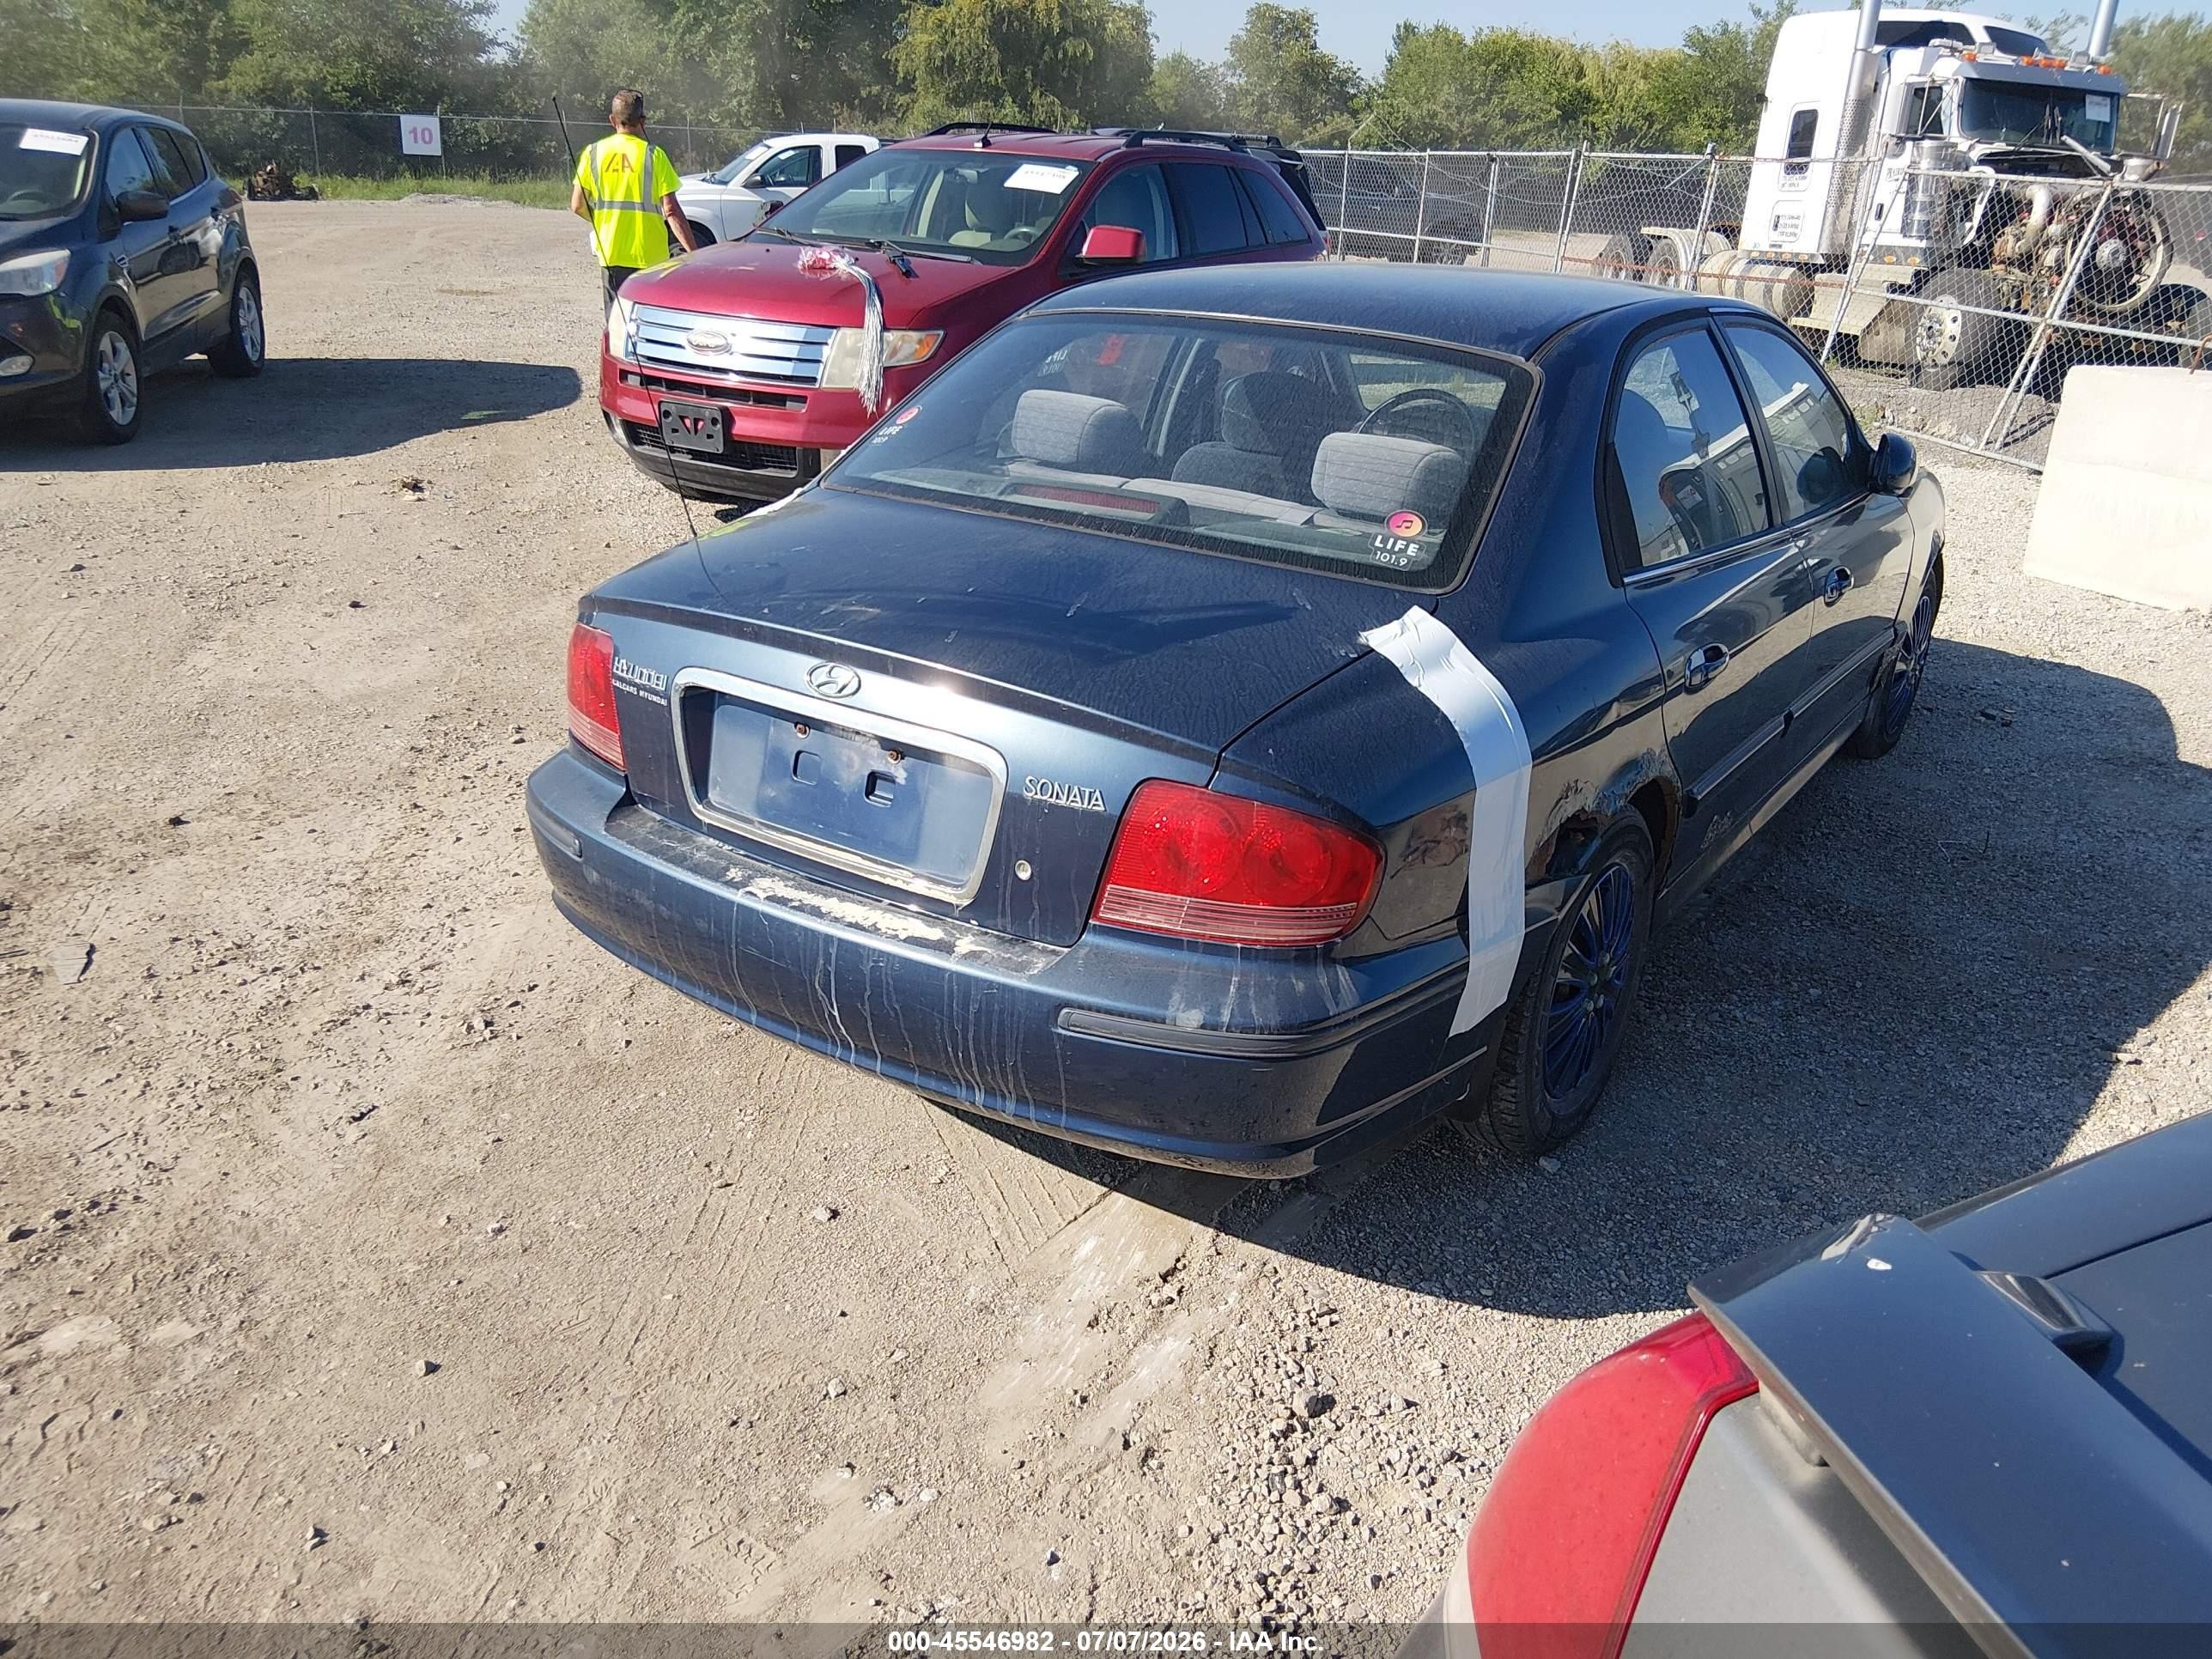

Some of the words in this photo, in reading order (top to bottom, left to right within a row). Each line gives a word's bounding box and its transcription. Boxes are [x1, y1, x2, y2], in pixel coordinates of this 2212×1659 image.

[409, 126, 434, 145] 10
[1374, 534, 1419, 556] LIFE
[1375, 550, 1408, 567] 101.9
[612, 657, 668, 691] HYUNDAI
[639, 690, 668, 707] HYUNDAI
[1023, 775, 1106, 811] SONATA
